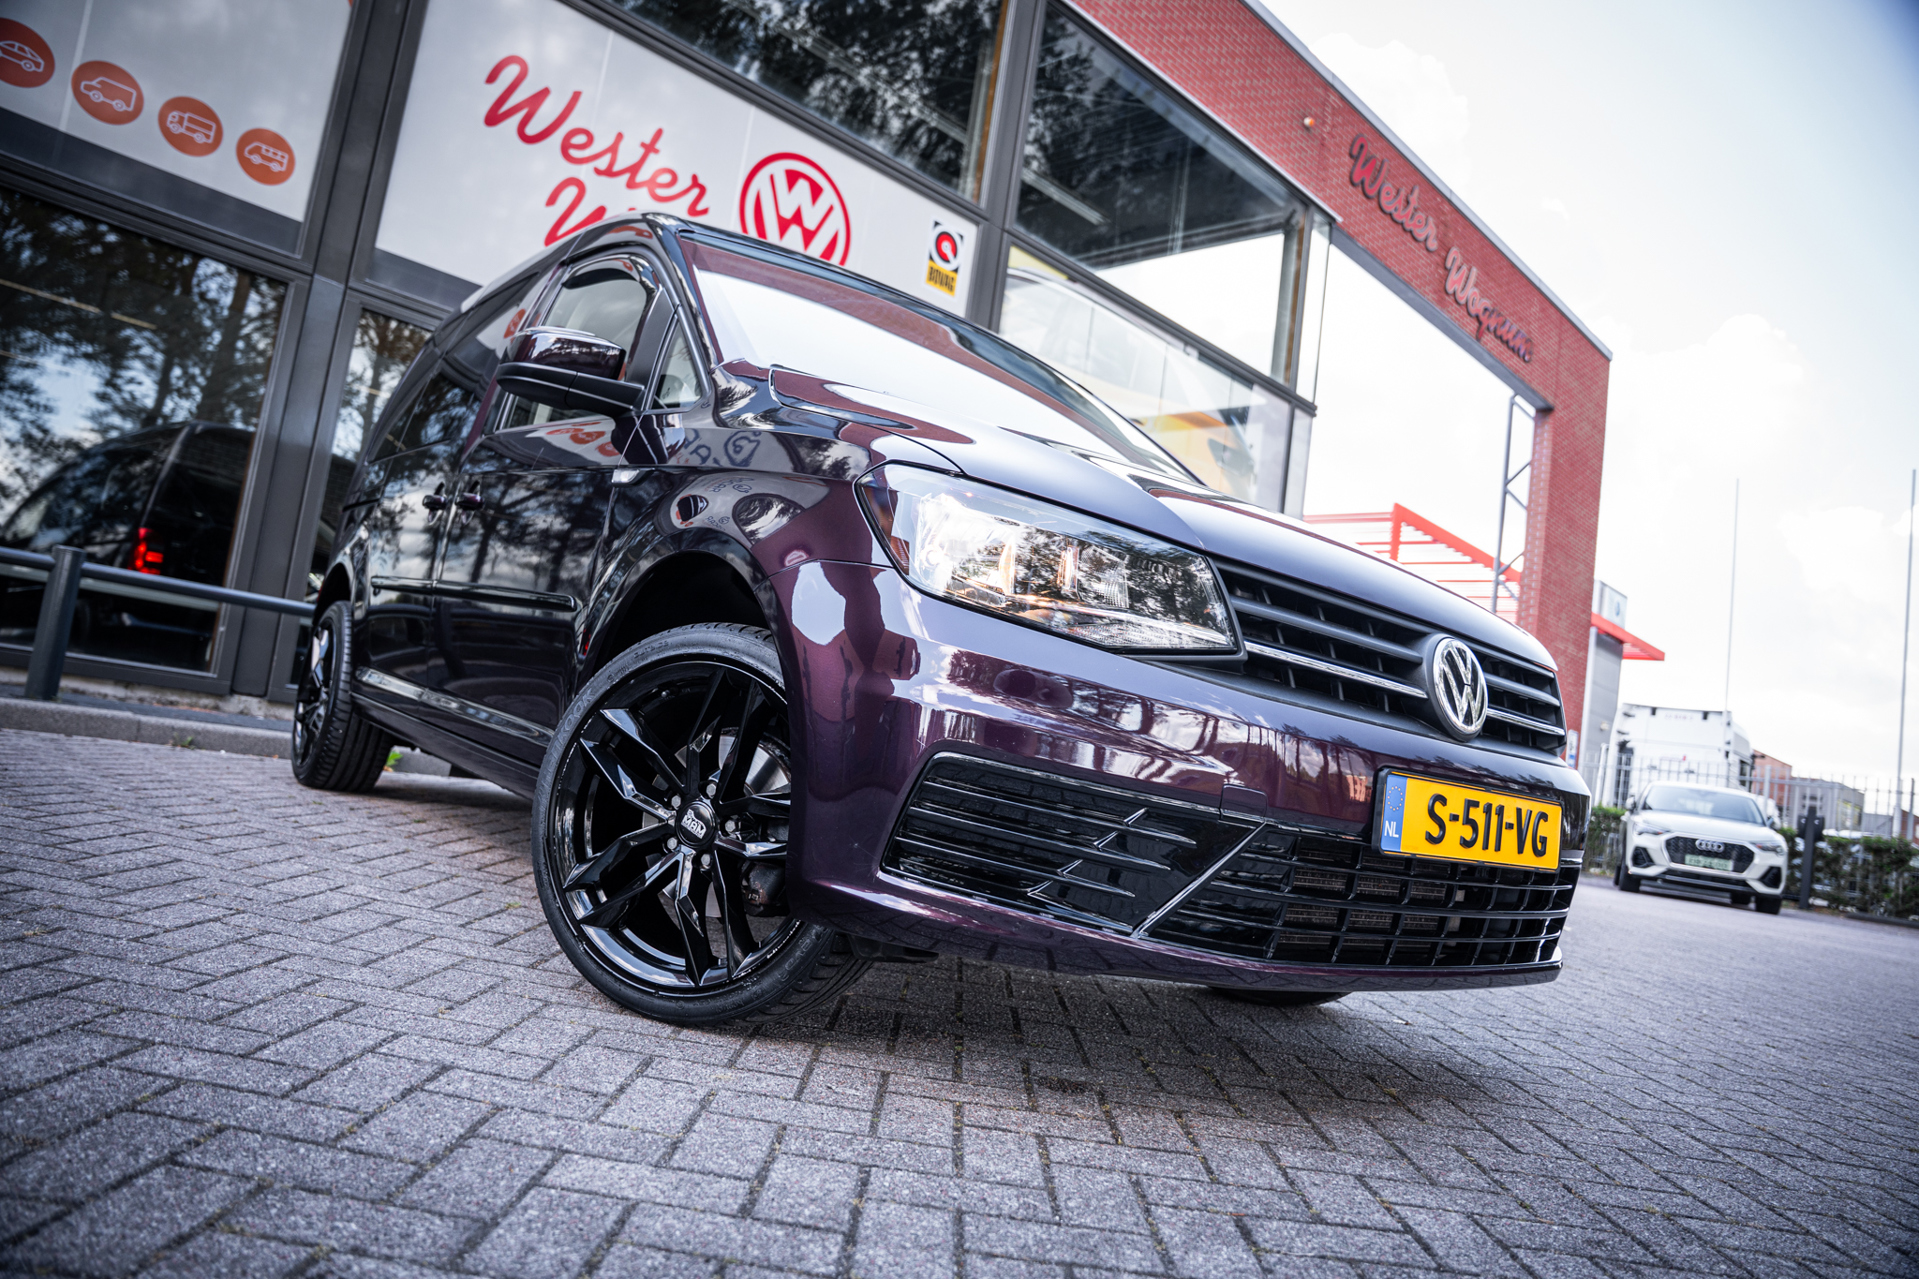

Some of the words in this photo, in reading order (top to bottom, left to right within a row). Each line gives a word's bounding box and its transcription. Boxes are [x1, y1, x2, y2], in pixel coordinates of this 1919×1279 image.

[484, 55, 709, 217] Wester
[1350, 134, 1437, 251] Wester
[1384, 820, 1399, 838] NL
[1425, 793, 1549, 858] S-511-VG
